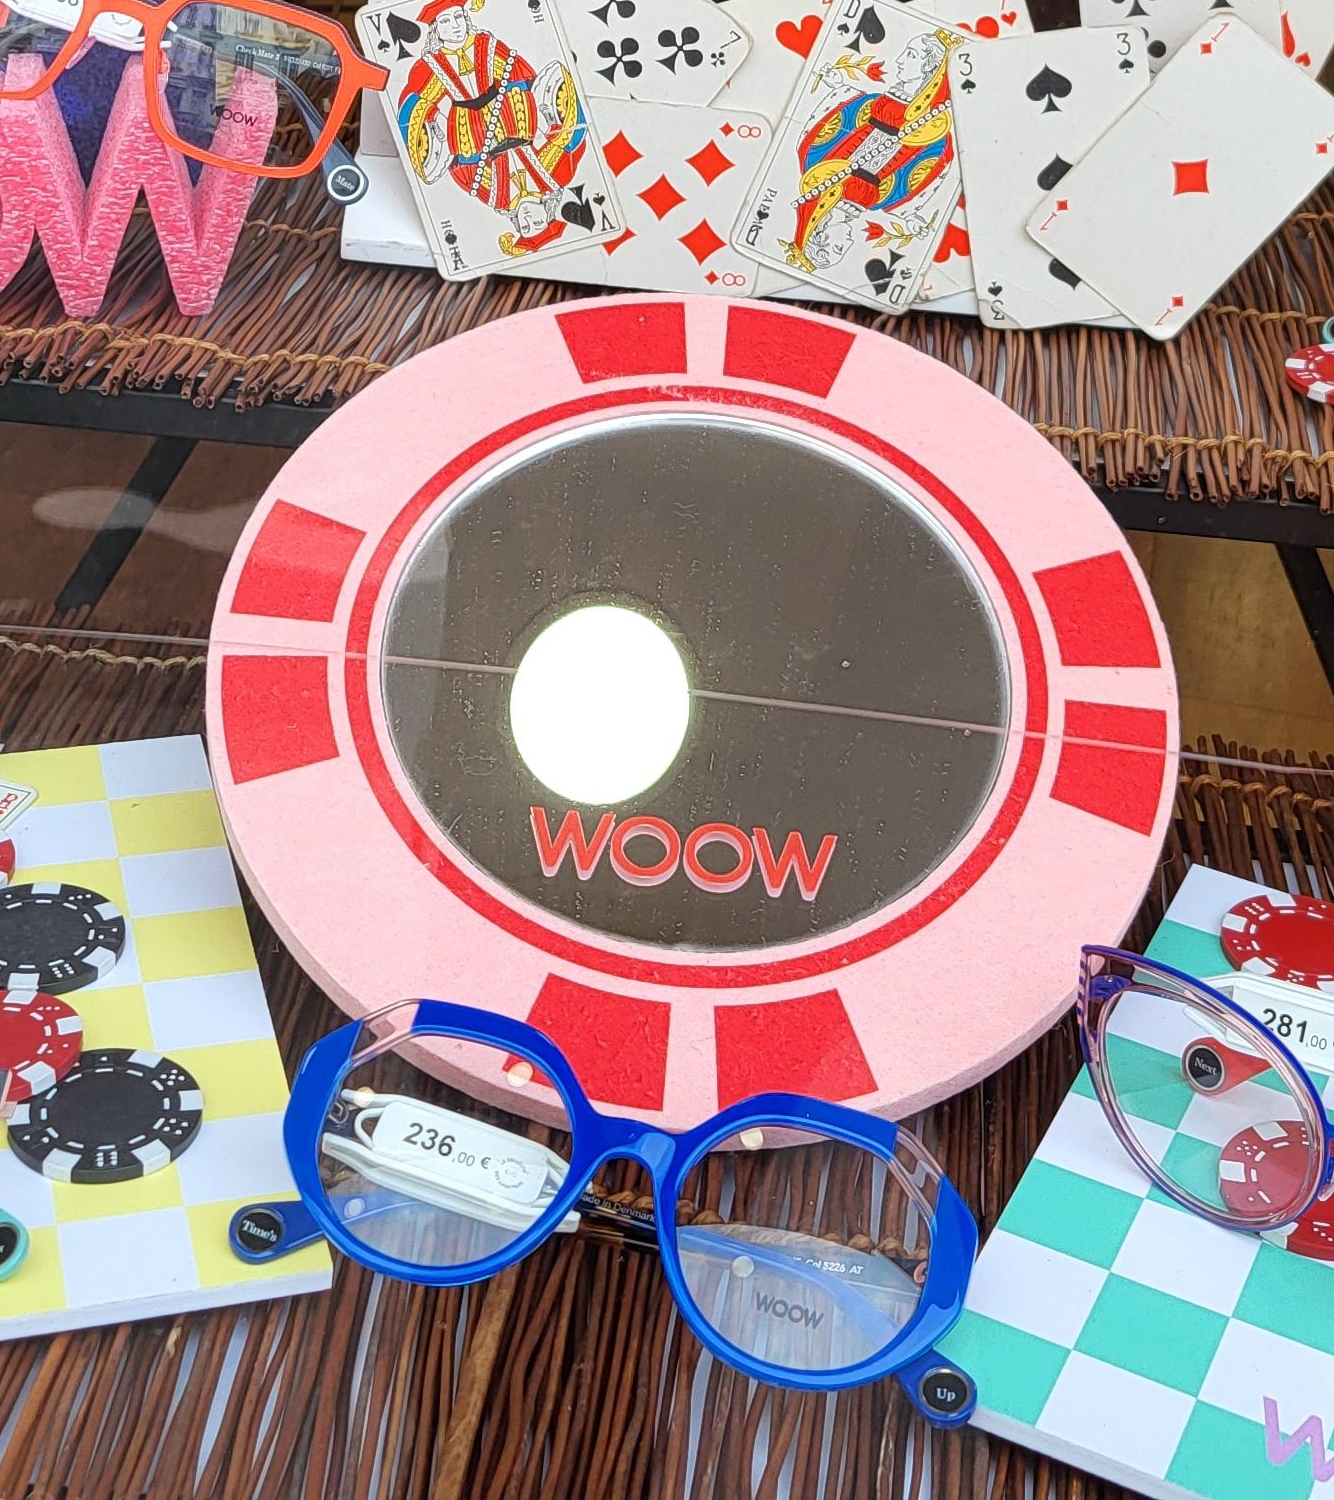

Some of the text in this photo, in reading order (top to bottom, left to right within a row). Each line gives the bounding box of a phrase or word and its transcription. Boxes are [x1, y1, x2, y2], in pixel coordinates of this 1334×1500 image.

[366, 12, 383, 36] V
[235, 44, 257, 56] Check
[257, 47, 275, 59] Mate
[720, 30, 742, 50] 7
[1116, 32, 1132, 56] 3
[958, 53, 974, 77] 3
[209, 103, 258, 127] WOOW
[736, 124, 762, 140] 8
[334, 174, 355, 191] Mate
[721, 272, 747, 288] 8
[888, 283, 907, 305] D
[529, 806, 838, 901] WOOW
[1262, 1008, 1328, 1051] 281,00
[1193, 1056, 1218, 1076] Next
[403, 1122, 492, 1170] 236,00 €
[578, 1193, 601, 1206] ade
[612, 1203, 656, 1223] Denmark
[240, 1217, 279, 1245] Time's
[822, 1260, 846, 1274] 5226
[850, 1265, 865, 1275] AT
[756, 1291, 825, 1330] WOOW
[936, 1386, 957, 1403] Up
